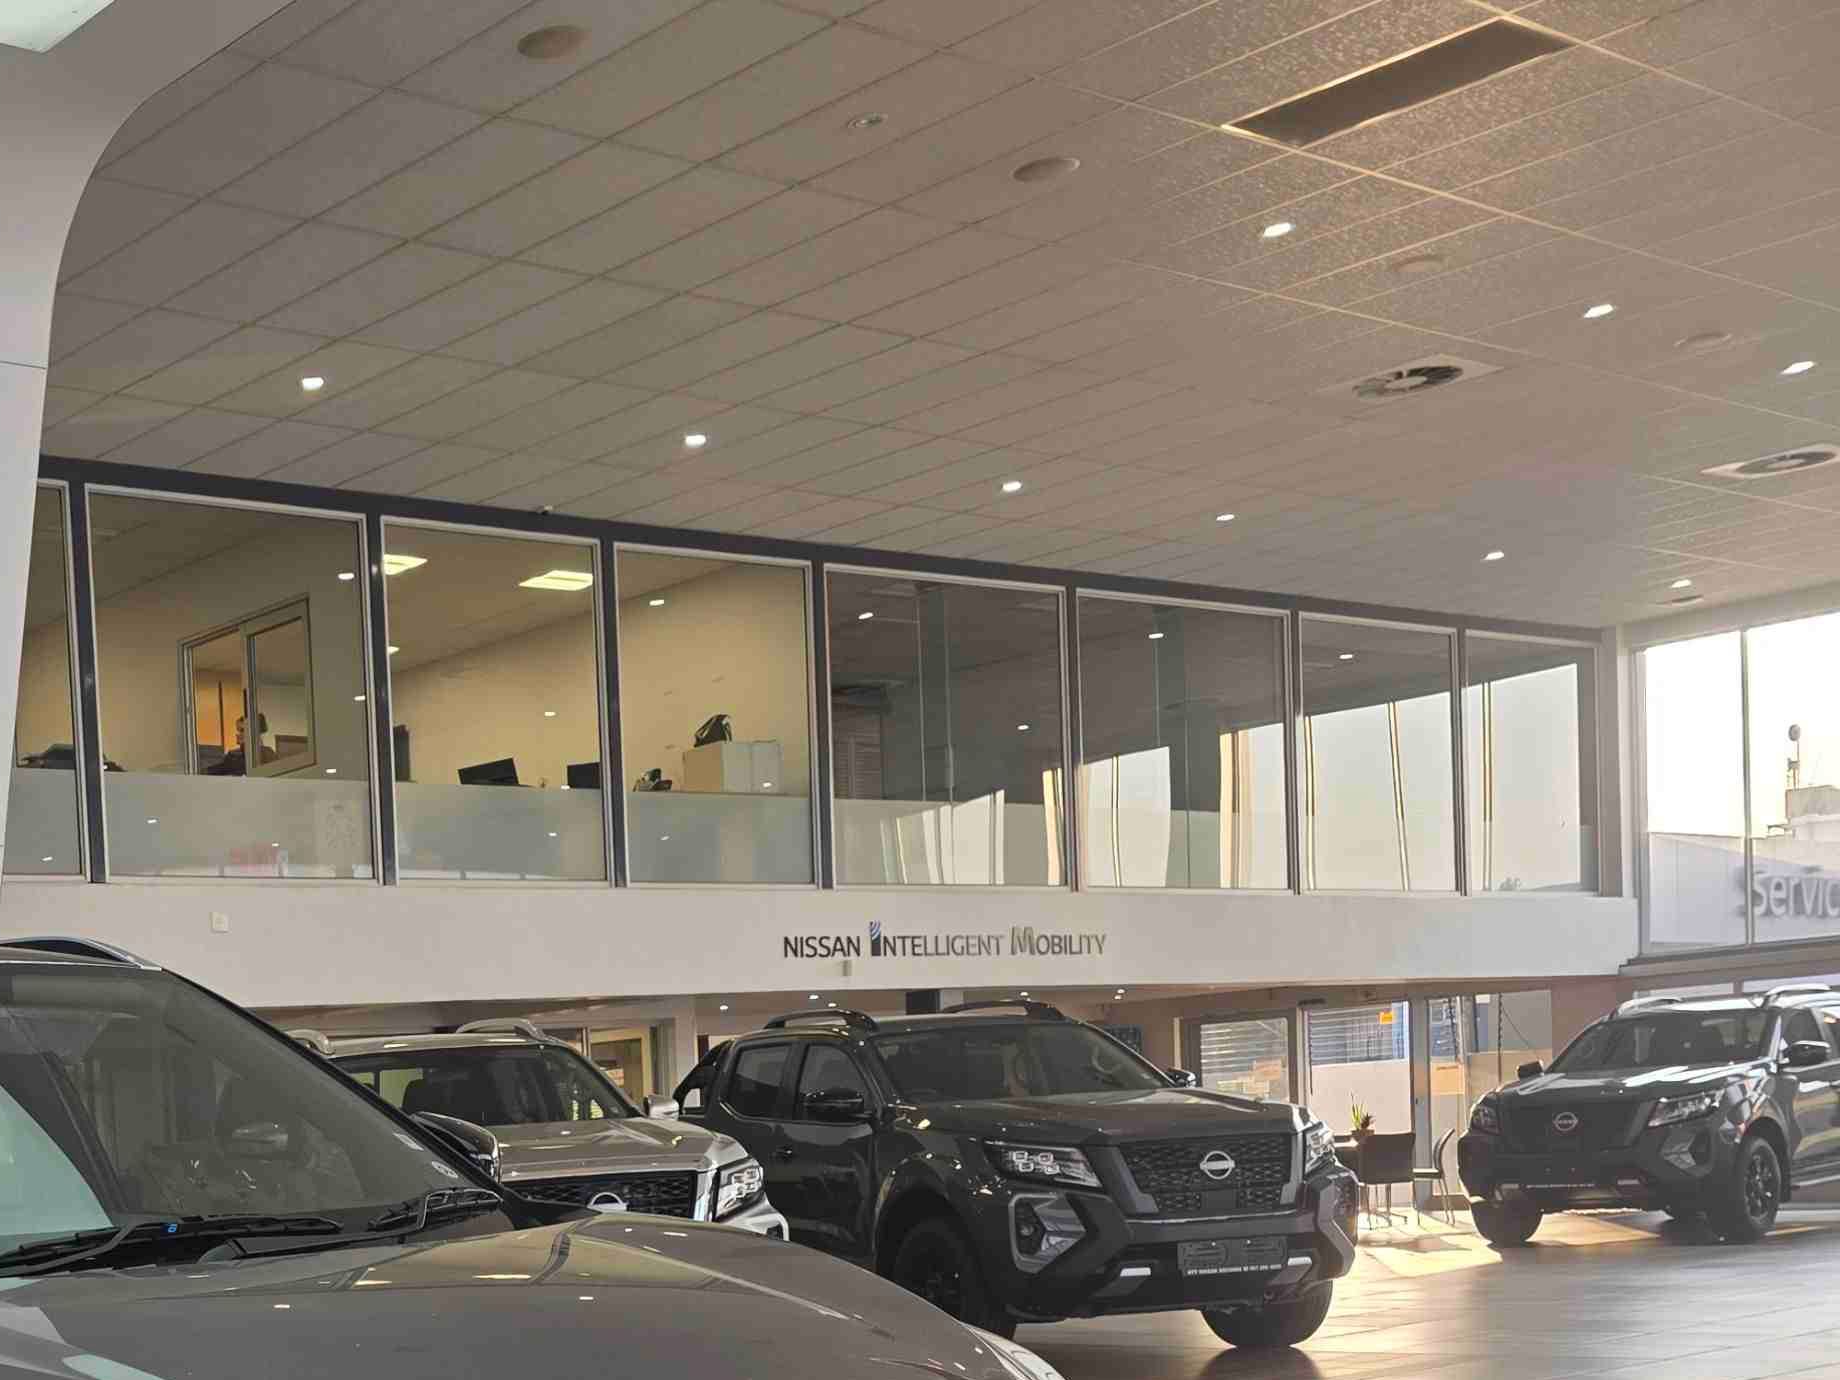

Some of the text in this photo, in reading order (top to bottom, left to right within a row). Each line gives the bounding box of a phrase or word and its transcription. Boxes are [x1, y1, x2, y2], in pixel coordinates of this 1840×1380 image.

[783, 920, 1107, 959] NISSAN INTELLIGENT MOBILITY
